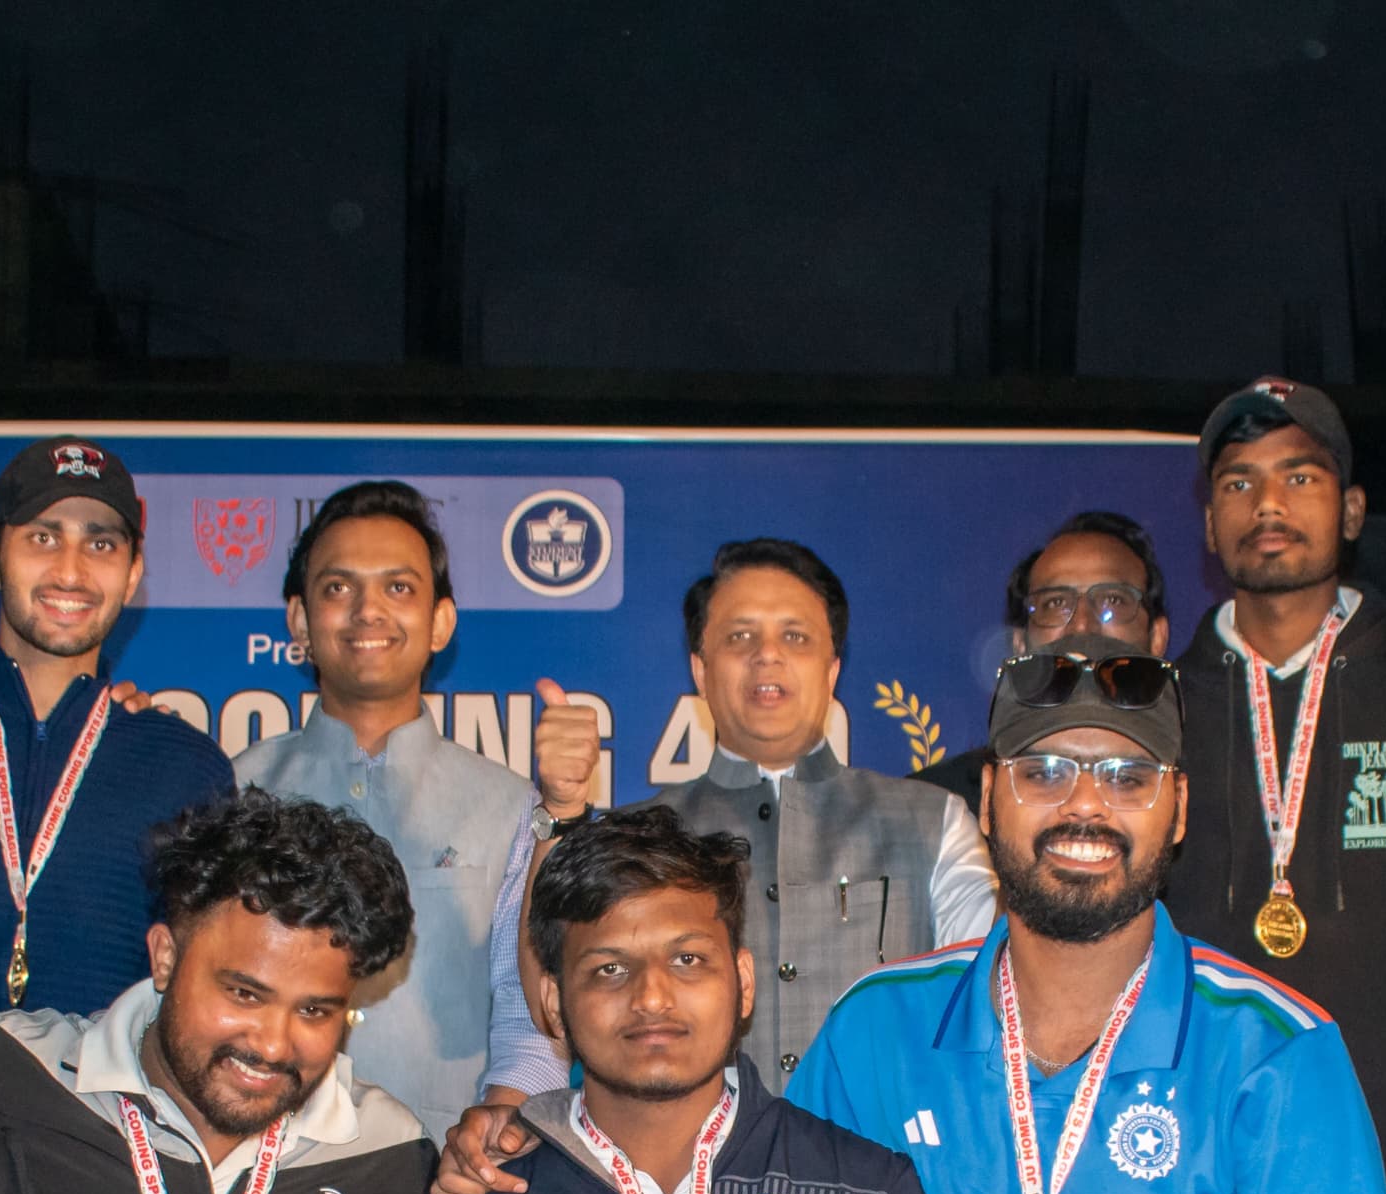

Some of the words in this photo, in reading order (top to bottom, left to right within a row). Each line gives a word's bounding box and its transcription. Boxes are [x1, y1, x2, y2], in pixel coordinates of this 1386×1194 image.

[247, 633, 310, 665] Pre
[1304, 667, 1324, 720] COMING
[1256, 700, 1271, 753] COMING
[1294, 723, 1312, 775] SPORTS
[34, 842, 47, 861] JU
[41, 804, 63, 841] HOME
[56, 758, 83, 804] COMING
[76, 718, 101, 758] SPORTS
[1262, 756, 1276, 794] HOME
[1268, 796, 1279, 815] JU
[1284, 777, 1302, 829] LEAGUE
[2, 817, 19, 868] LEAGUE
[1003, 996, 1019, 1049] SPORTS
[1093, 1007, 1128, 1065] COMING
[719, 1094, 734, 1113] JU
[1010, 1051, 1027, 1111] COMING
[1071, 1066, 1101, 1129] SPORTS
[126, 1109, 153, 1171] COMING
[264, 1115, 282, 1148] SPO
[699, 1111, 727, 1146] HOME
[1017, 1114, 1033, 1160] HOME
[1024, 1164, 1037, 1185] JU
